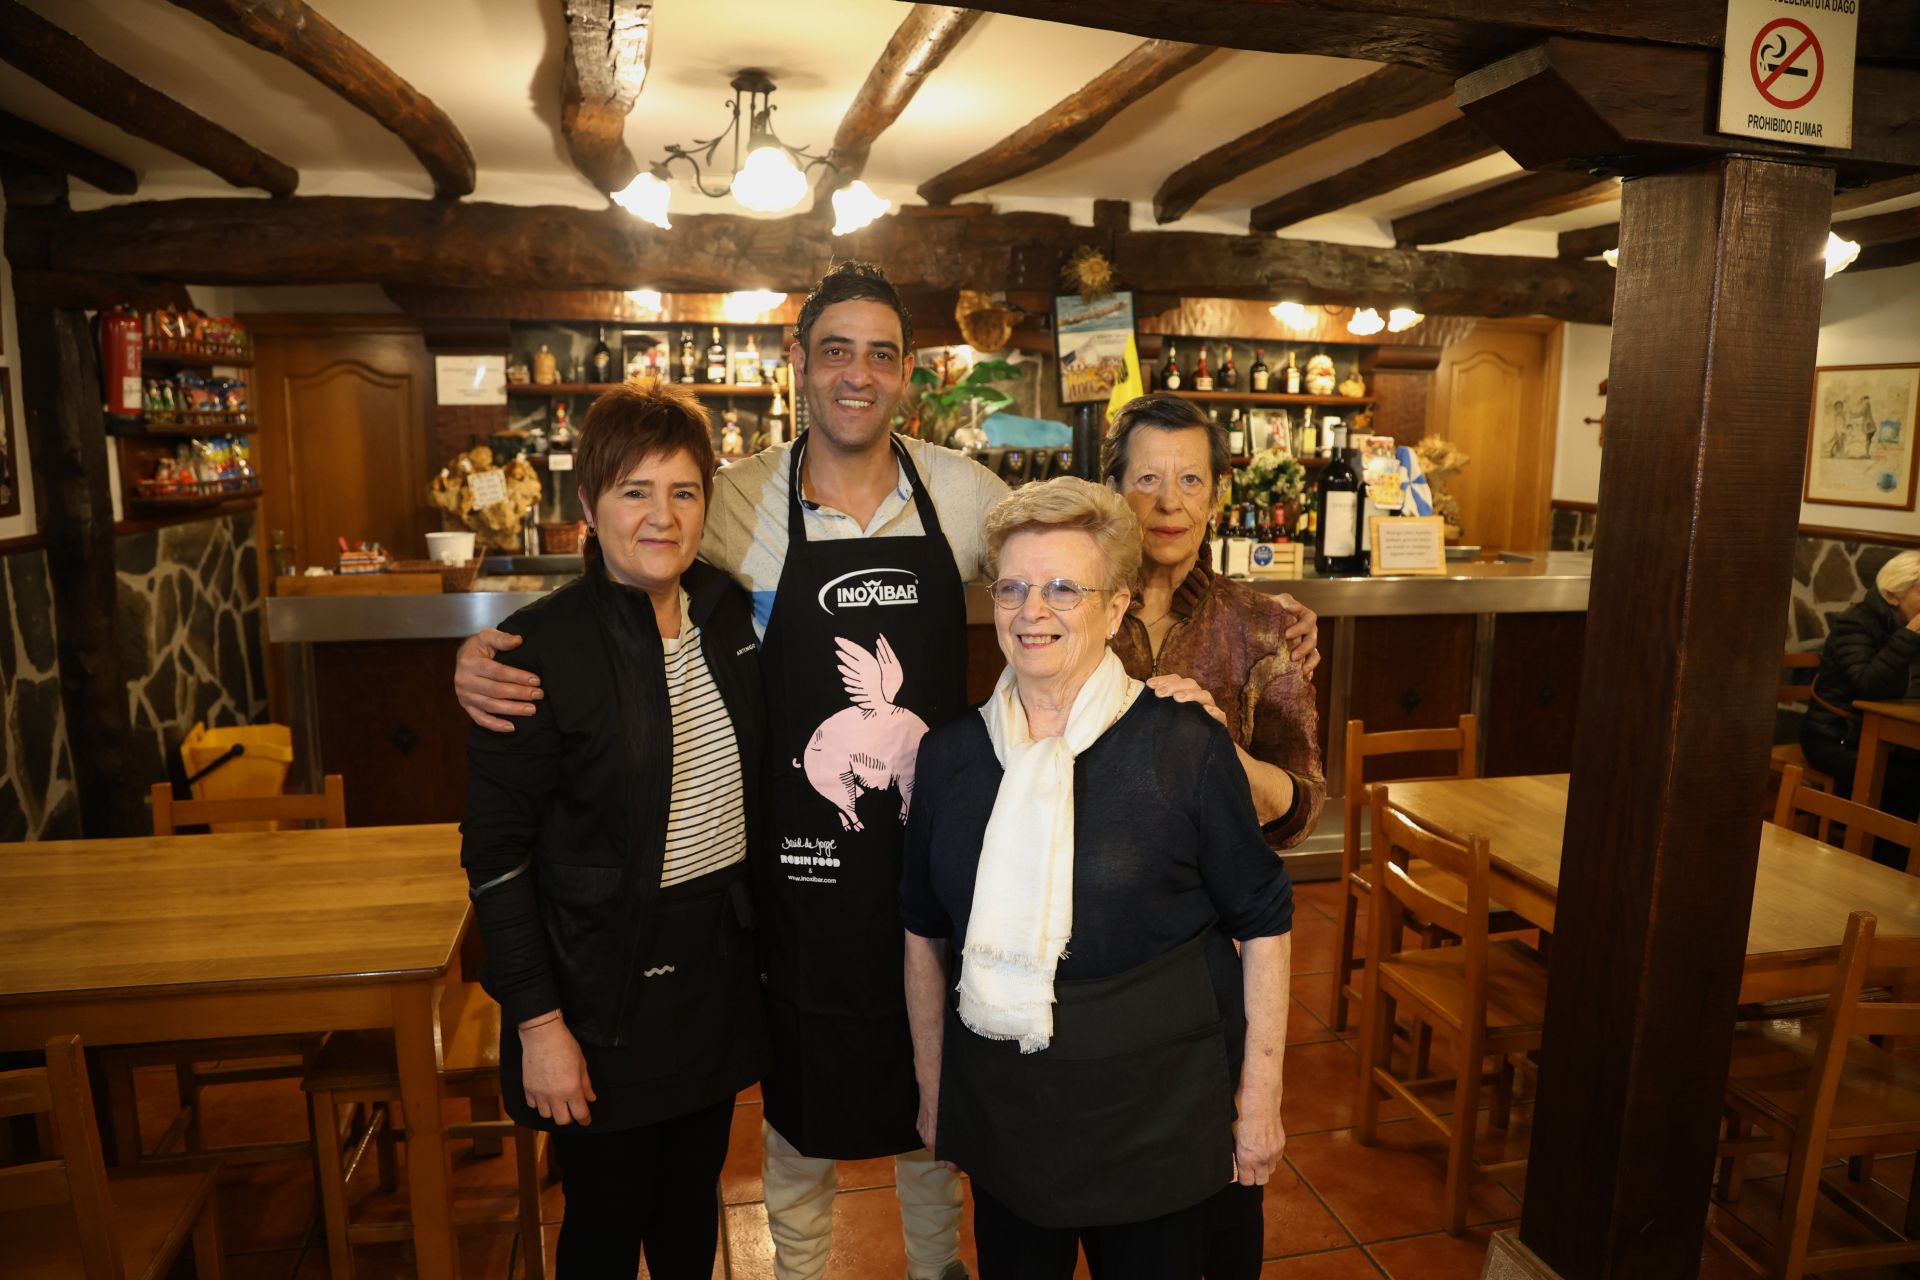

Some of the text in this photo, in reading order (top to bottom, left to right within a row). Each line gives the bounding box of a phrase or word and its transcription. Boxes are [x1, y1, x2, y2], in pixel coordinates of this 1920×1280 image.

[1832, 0, 1855, 14] DAGO
[1747, 114, 1823, 138] PROHIBIDO FUMAR
[837, 584, 918, 606] INOXIBAR
[780, 854, 841, 868] ROBIN FOOD
